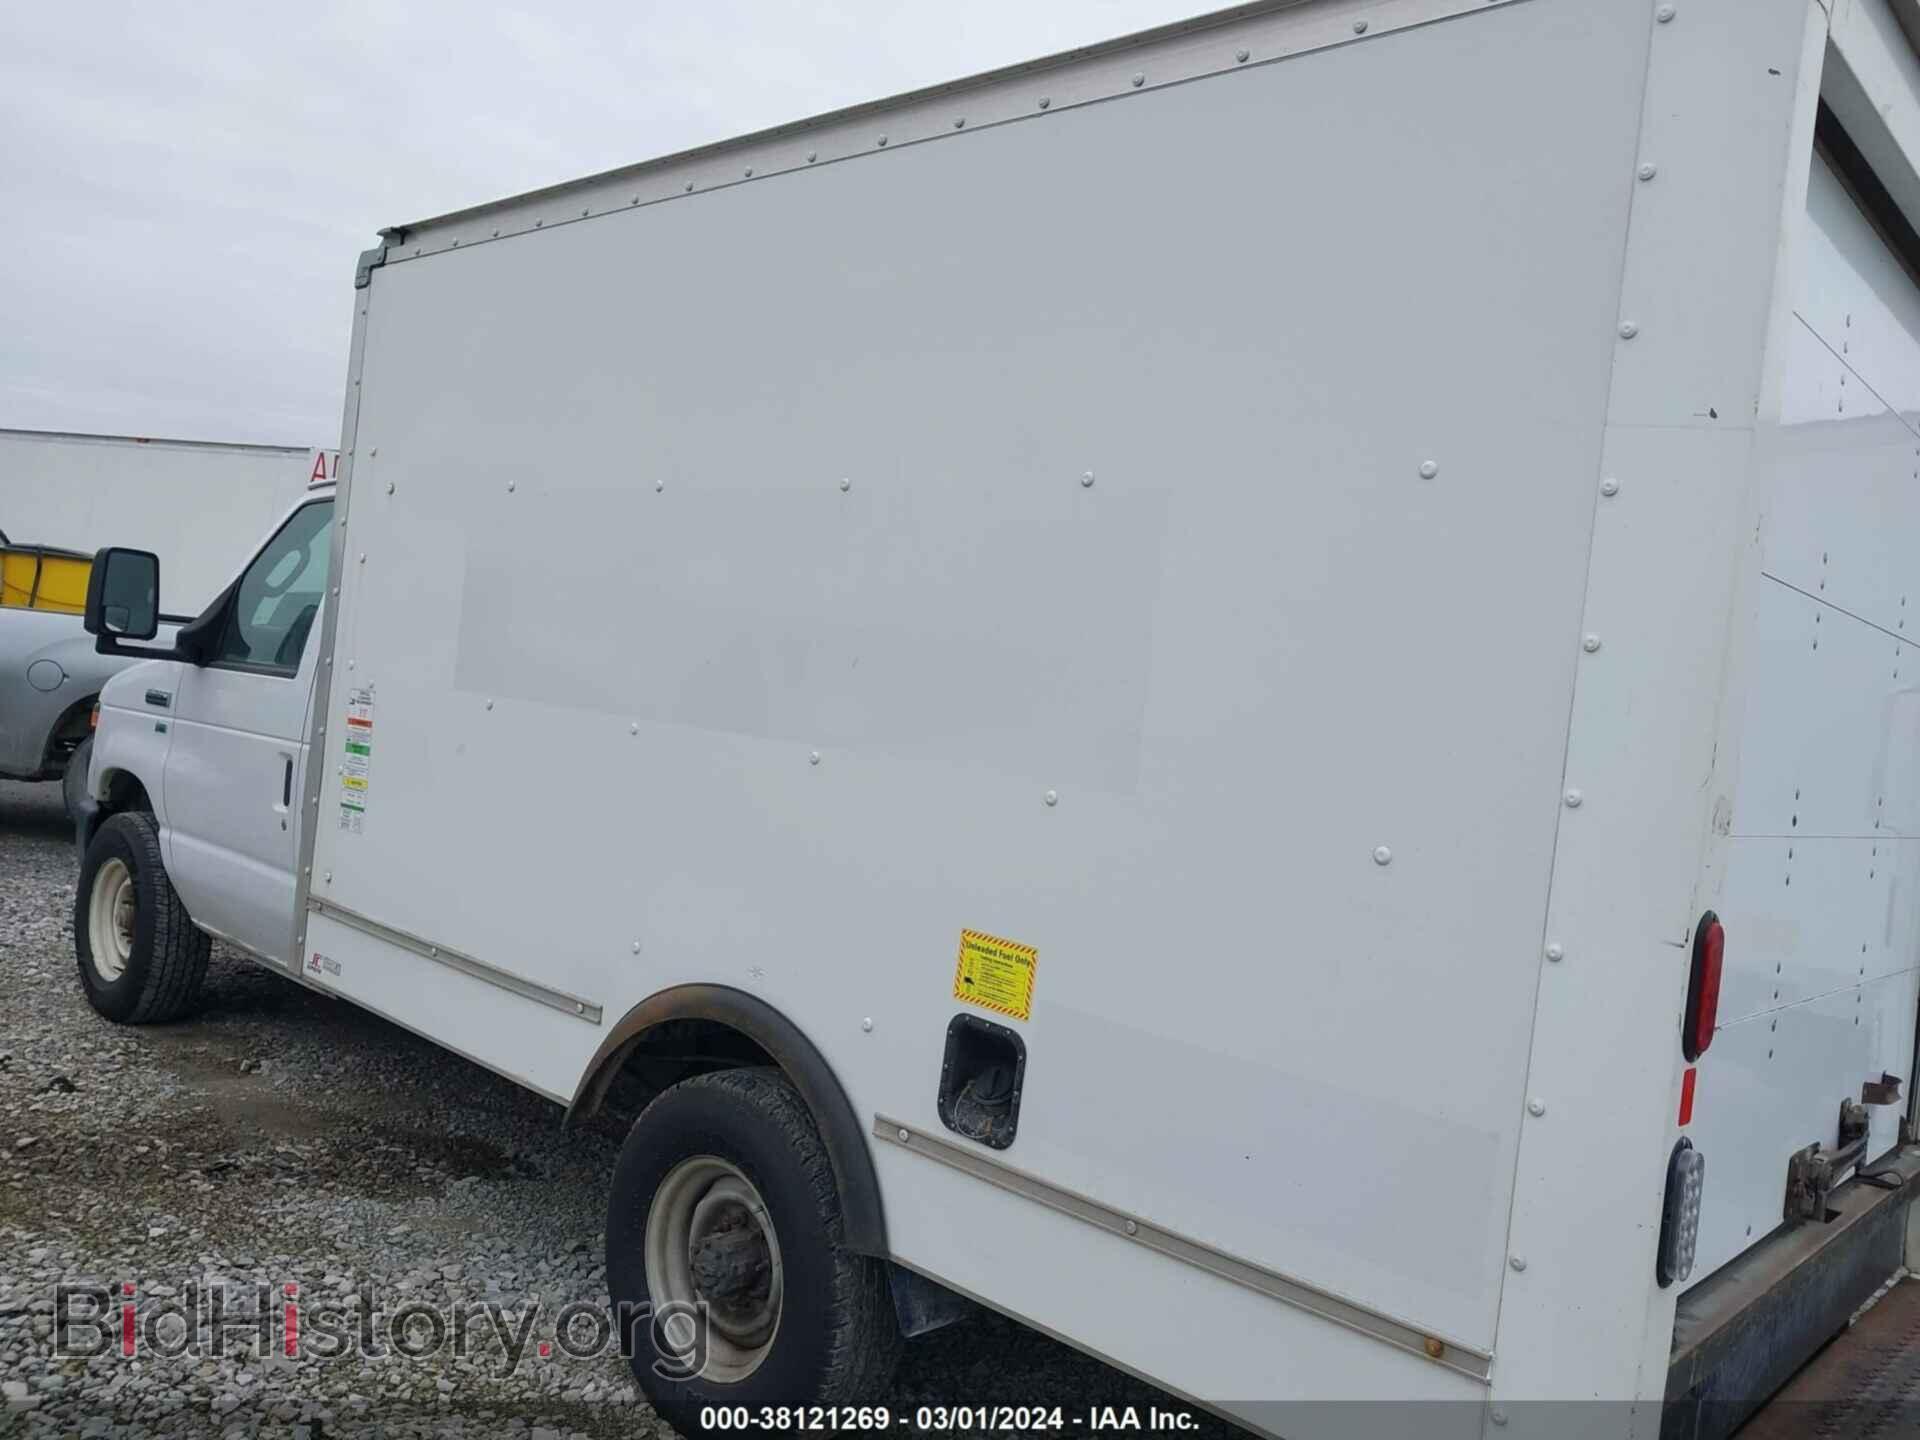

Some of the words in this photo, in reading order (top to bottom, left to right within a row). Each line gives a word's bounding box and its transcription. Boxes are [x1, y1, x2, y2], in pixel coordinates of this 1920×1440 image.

[966, 942, 998, 956] Unleaded
[999, 949, 1014, 961] Fuel
[1014, 954, 1031, 967] Only
